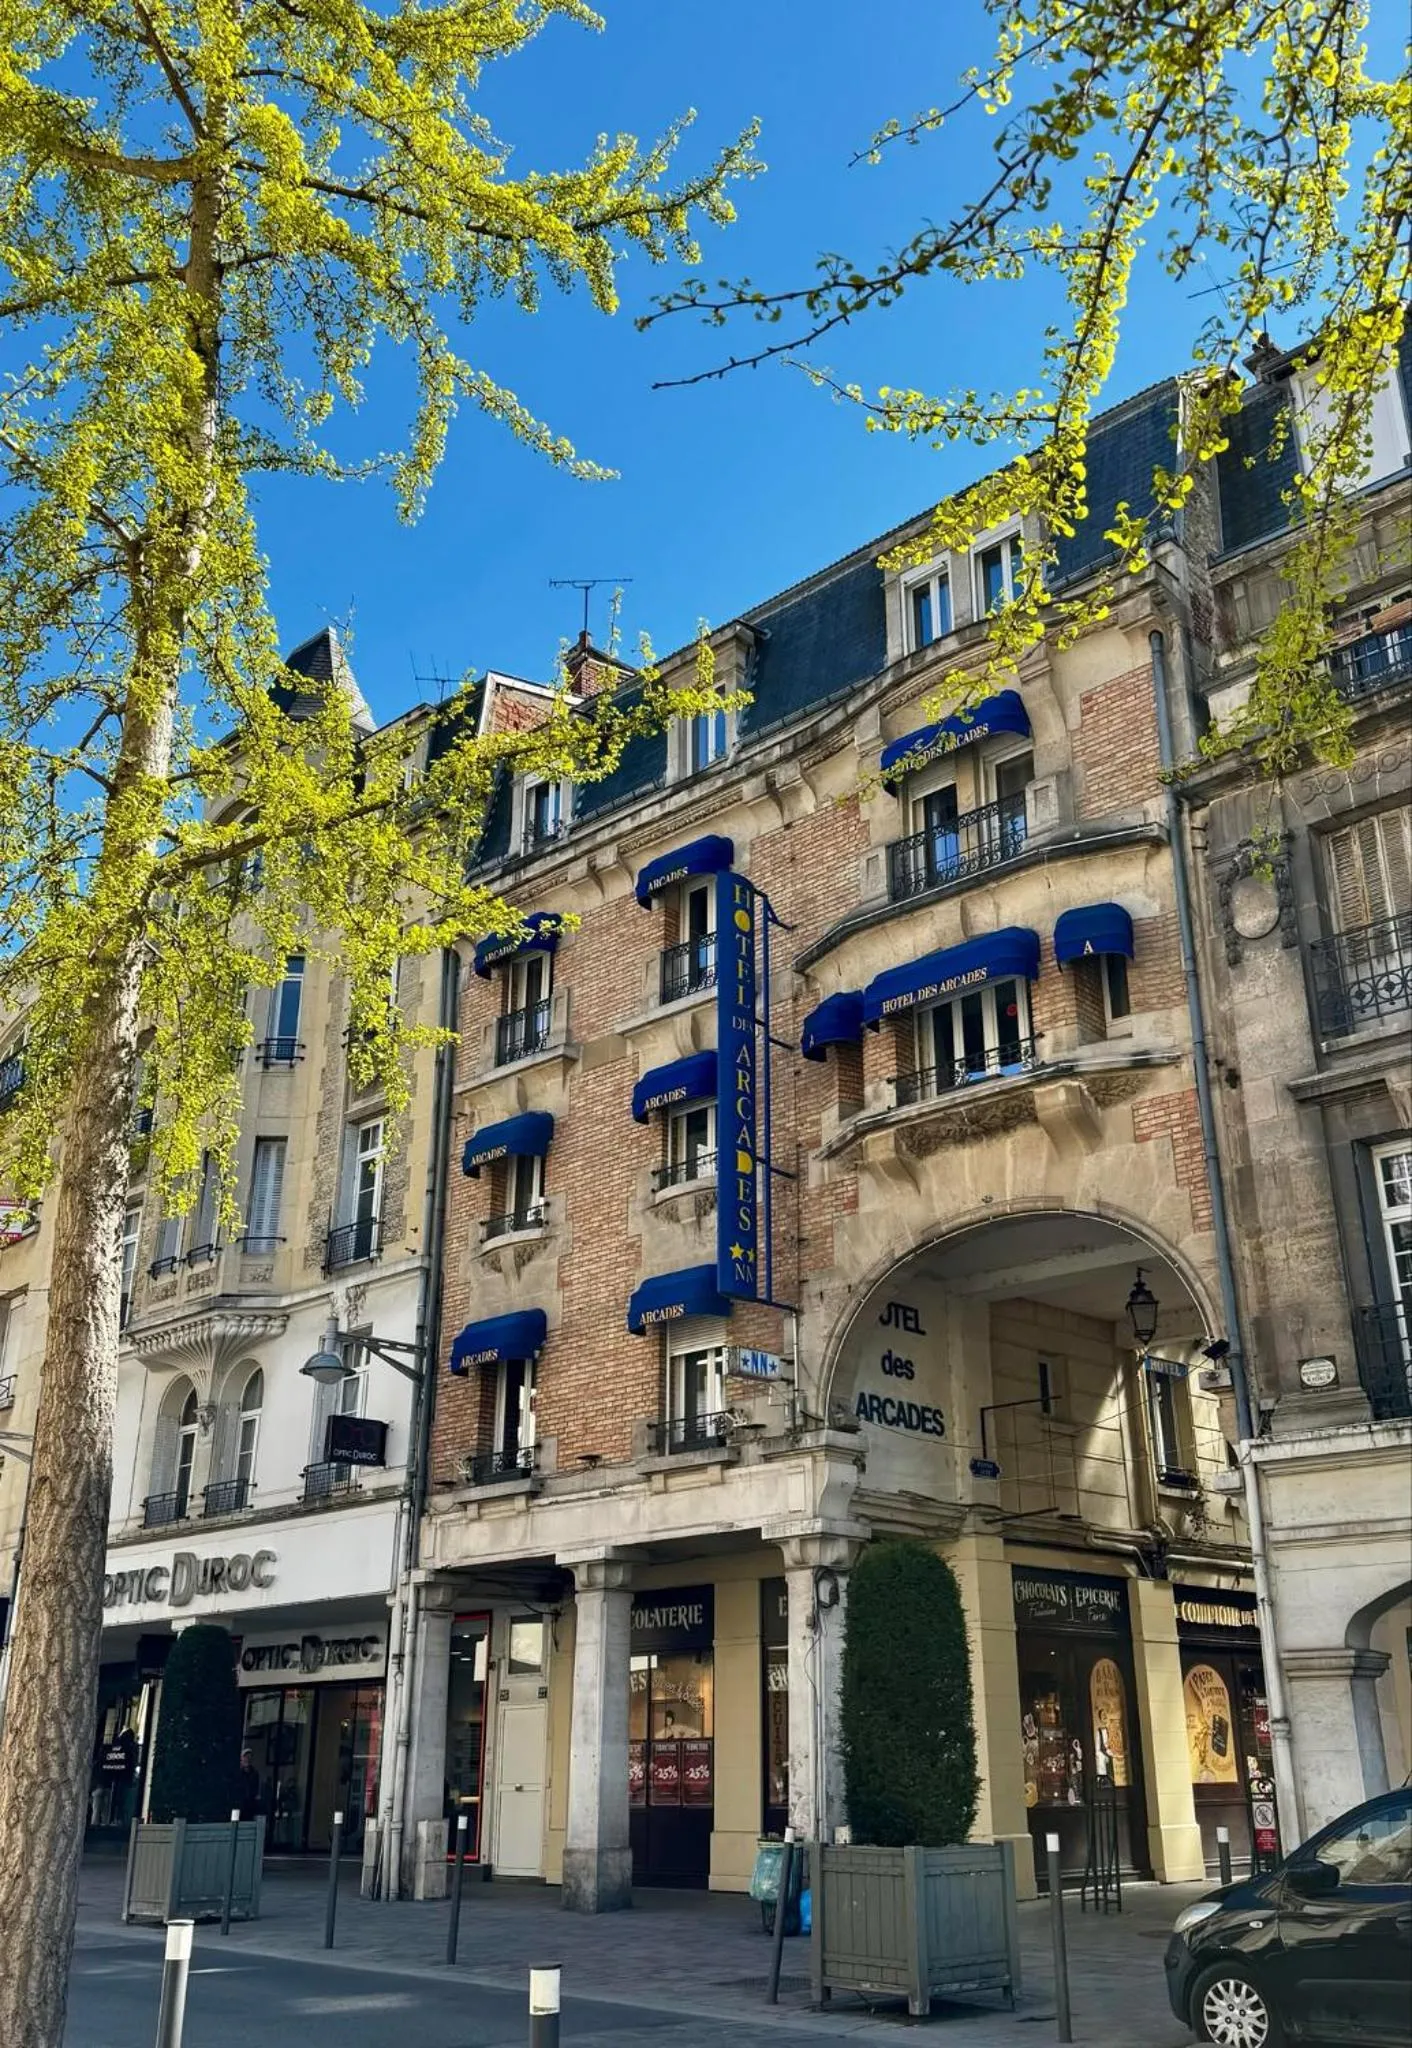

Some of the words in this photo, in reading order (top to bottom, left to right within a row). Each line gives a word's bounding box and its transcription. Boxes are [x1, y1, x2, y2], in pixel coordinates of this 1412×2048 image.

[647, 866, 689, 891] ARCADES
[733, 883, 751, 1009] HOTEL
[1083, 940, 1094, 955] A
[882, 993, 917, 1014] HOTEL
[918, 983, 938, 1001] DES
[940, 967, 987, 993] ARCADES
[644, 1086, 687, 1111] ARCADES
[735, 1044, 753, 1232] ARCADES
[469, 1144, 508, 1167] ARCADES
[639, 1303, 685, 1326] ARCADES
[460, 1347, 499, 1368] ARCADES
[881, 1349, 915, 1381] des
[855, 1391, 946, 1437] ARCADES
[102, 1565, 170, 1609] OPTIC
[169, 1549, 277, 1607] DUROC
[1013, 1579, 1068, 1607] CHOCOLATS
[241, 1643, 300, 1672] OPTIC
[300, 1634, 382, 1674] DUROC
[655, 1764, 678, 1780] -25%
[686, 1764, 710, 1780] -25%
